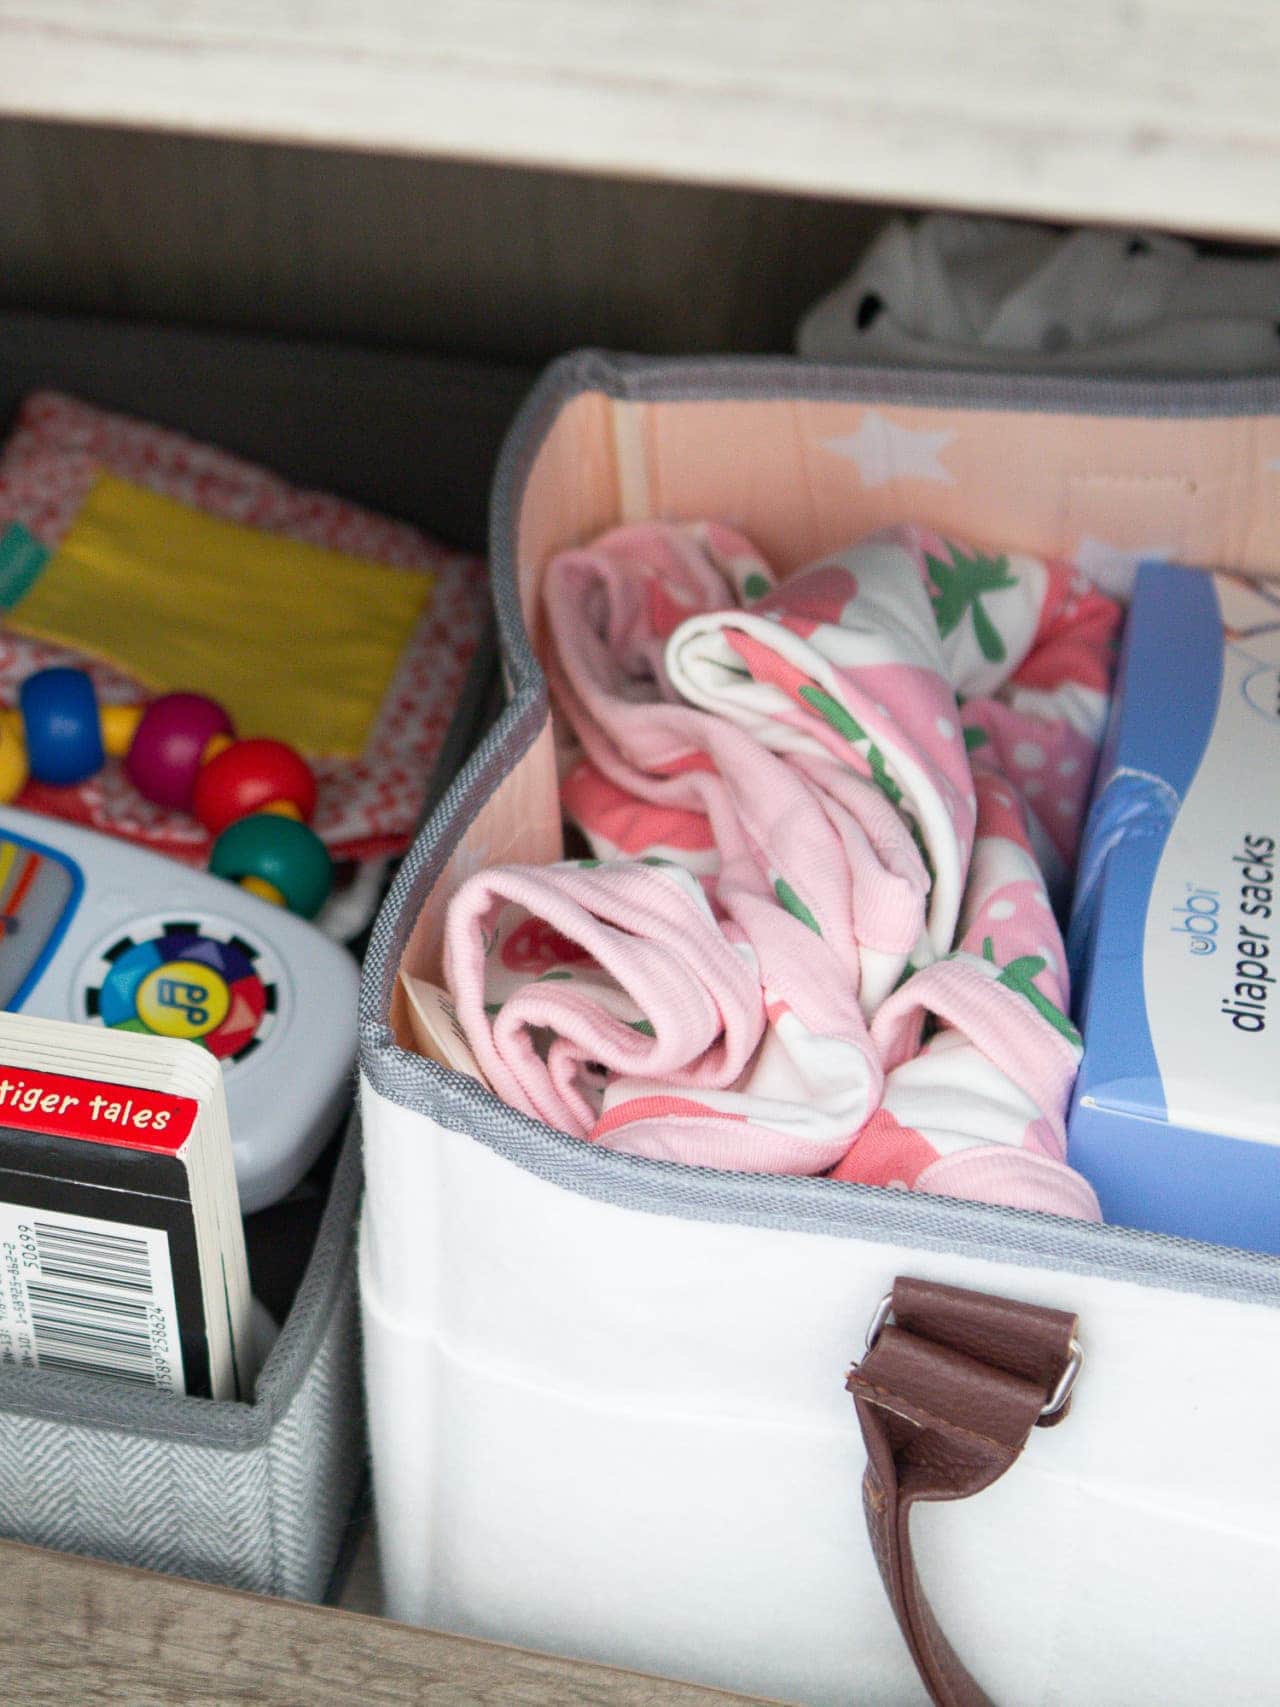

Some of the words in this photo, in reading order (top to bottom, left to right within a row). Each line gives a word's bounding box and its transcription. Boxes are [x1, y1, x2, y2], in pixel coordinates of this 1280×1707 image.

[1232, 834, 1275, 919] sacks
[1221, 924, 1277, 1032] diaper
[89, 1095, 171, 1130] tales
[18, 1224, 40, 1270] 50699
[3, 1242, 29, 1324] 1-58925-862-2
[149, 1307, 169, 1353] 258624
